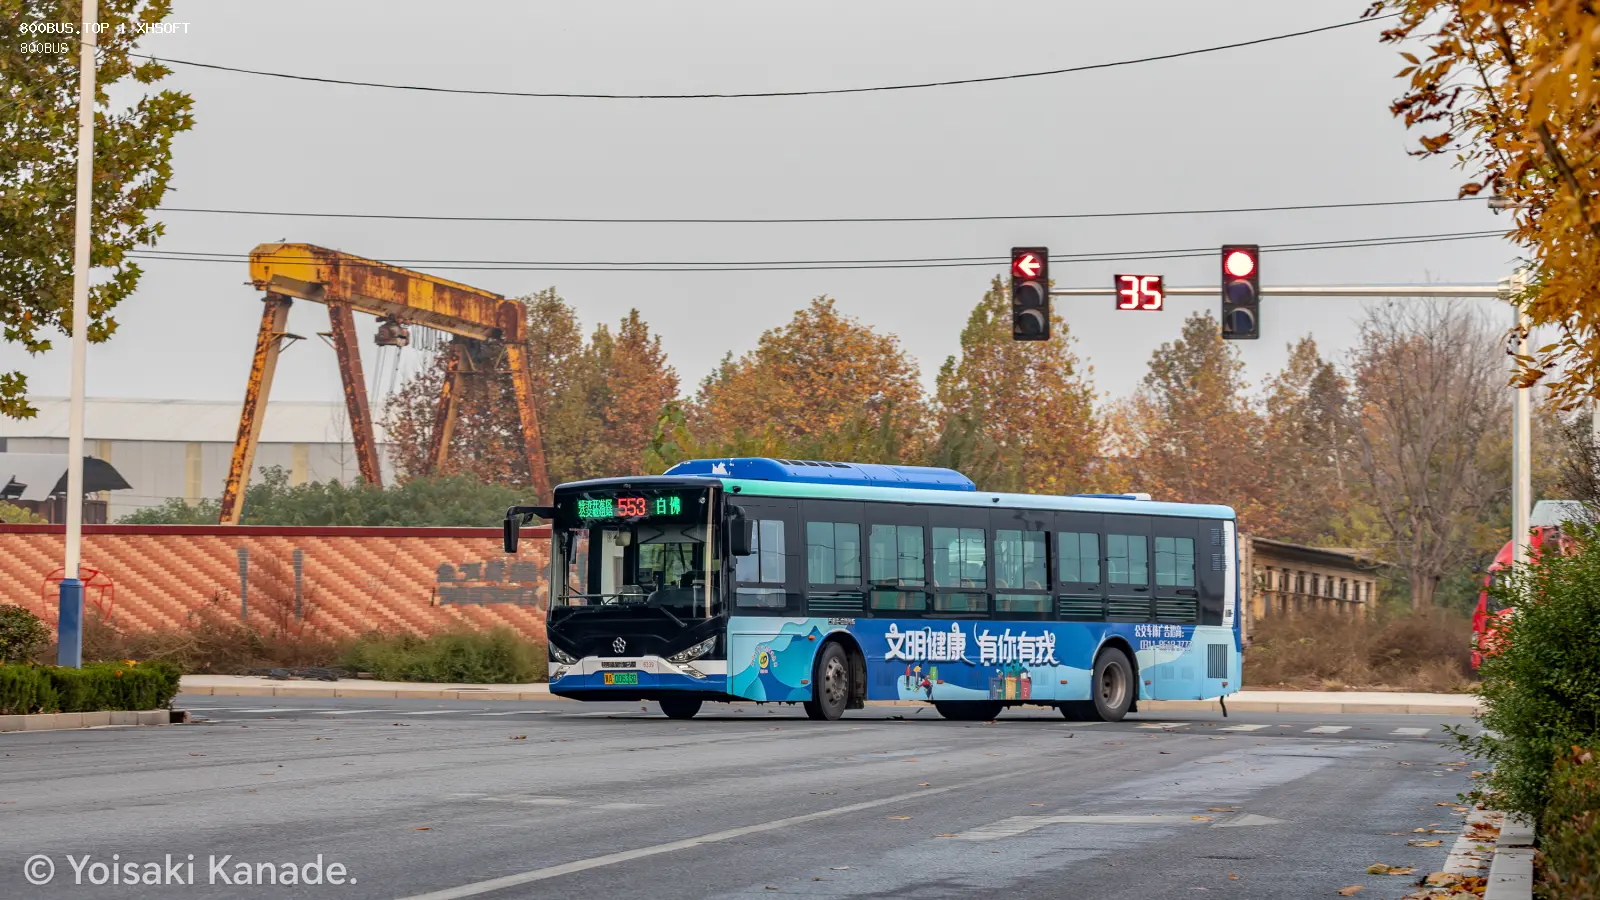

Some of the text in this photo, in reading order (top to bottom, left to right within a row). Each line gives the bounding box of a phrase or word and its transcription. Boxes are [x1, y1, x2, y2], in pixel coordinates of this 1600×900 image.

[1120, 275, 1162, 310] 35
[617, 497, 646, 517] 553
[656, 495, 681, 515] 白佛
[884, 622, 976, 665] 文明健康
[973, 622, 1060, 665] 有你有我
